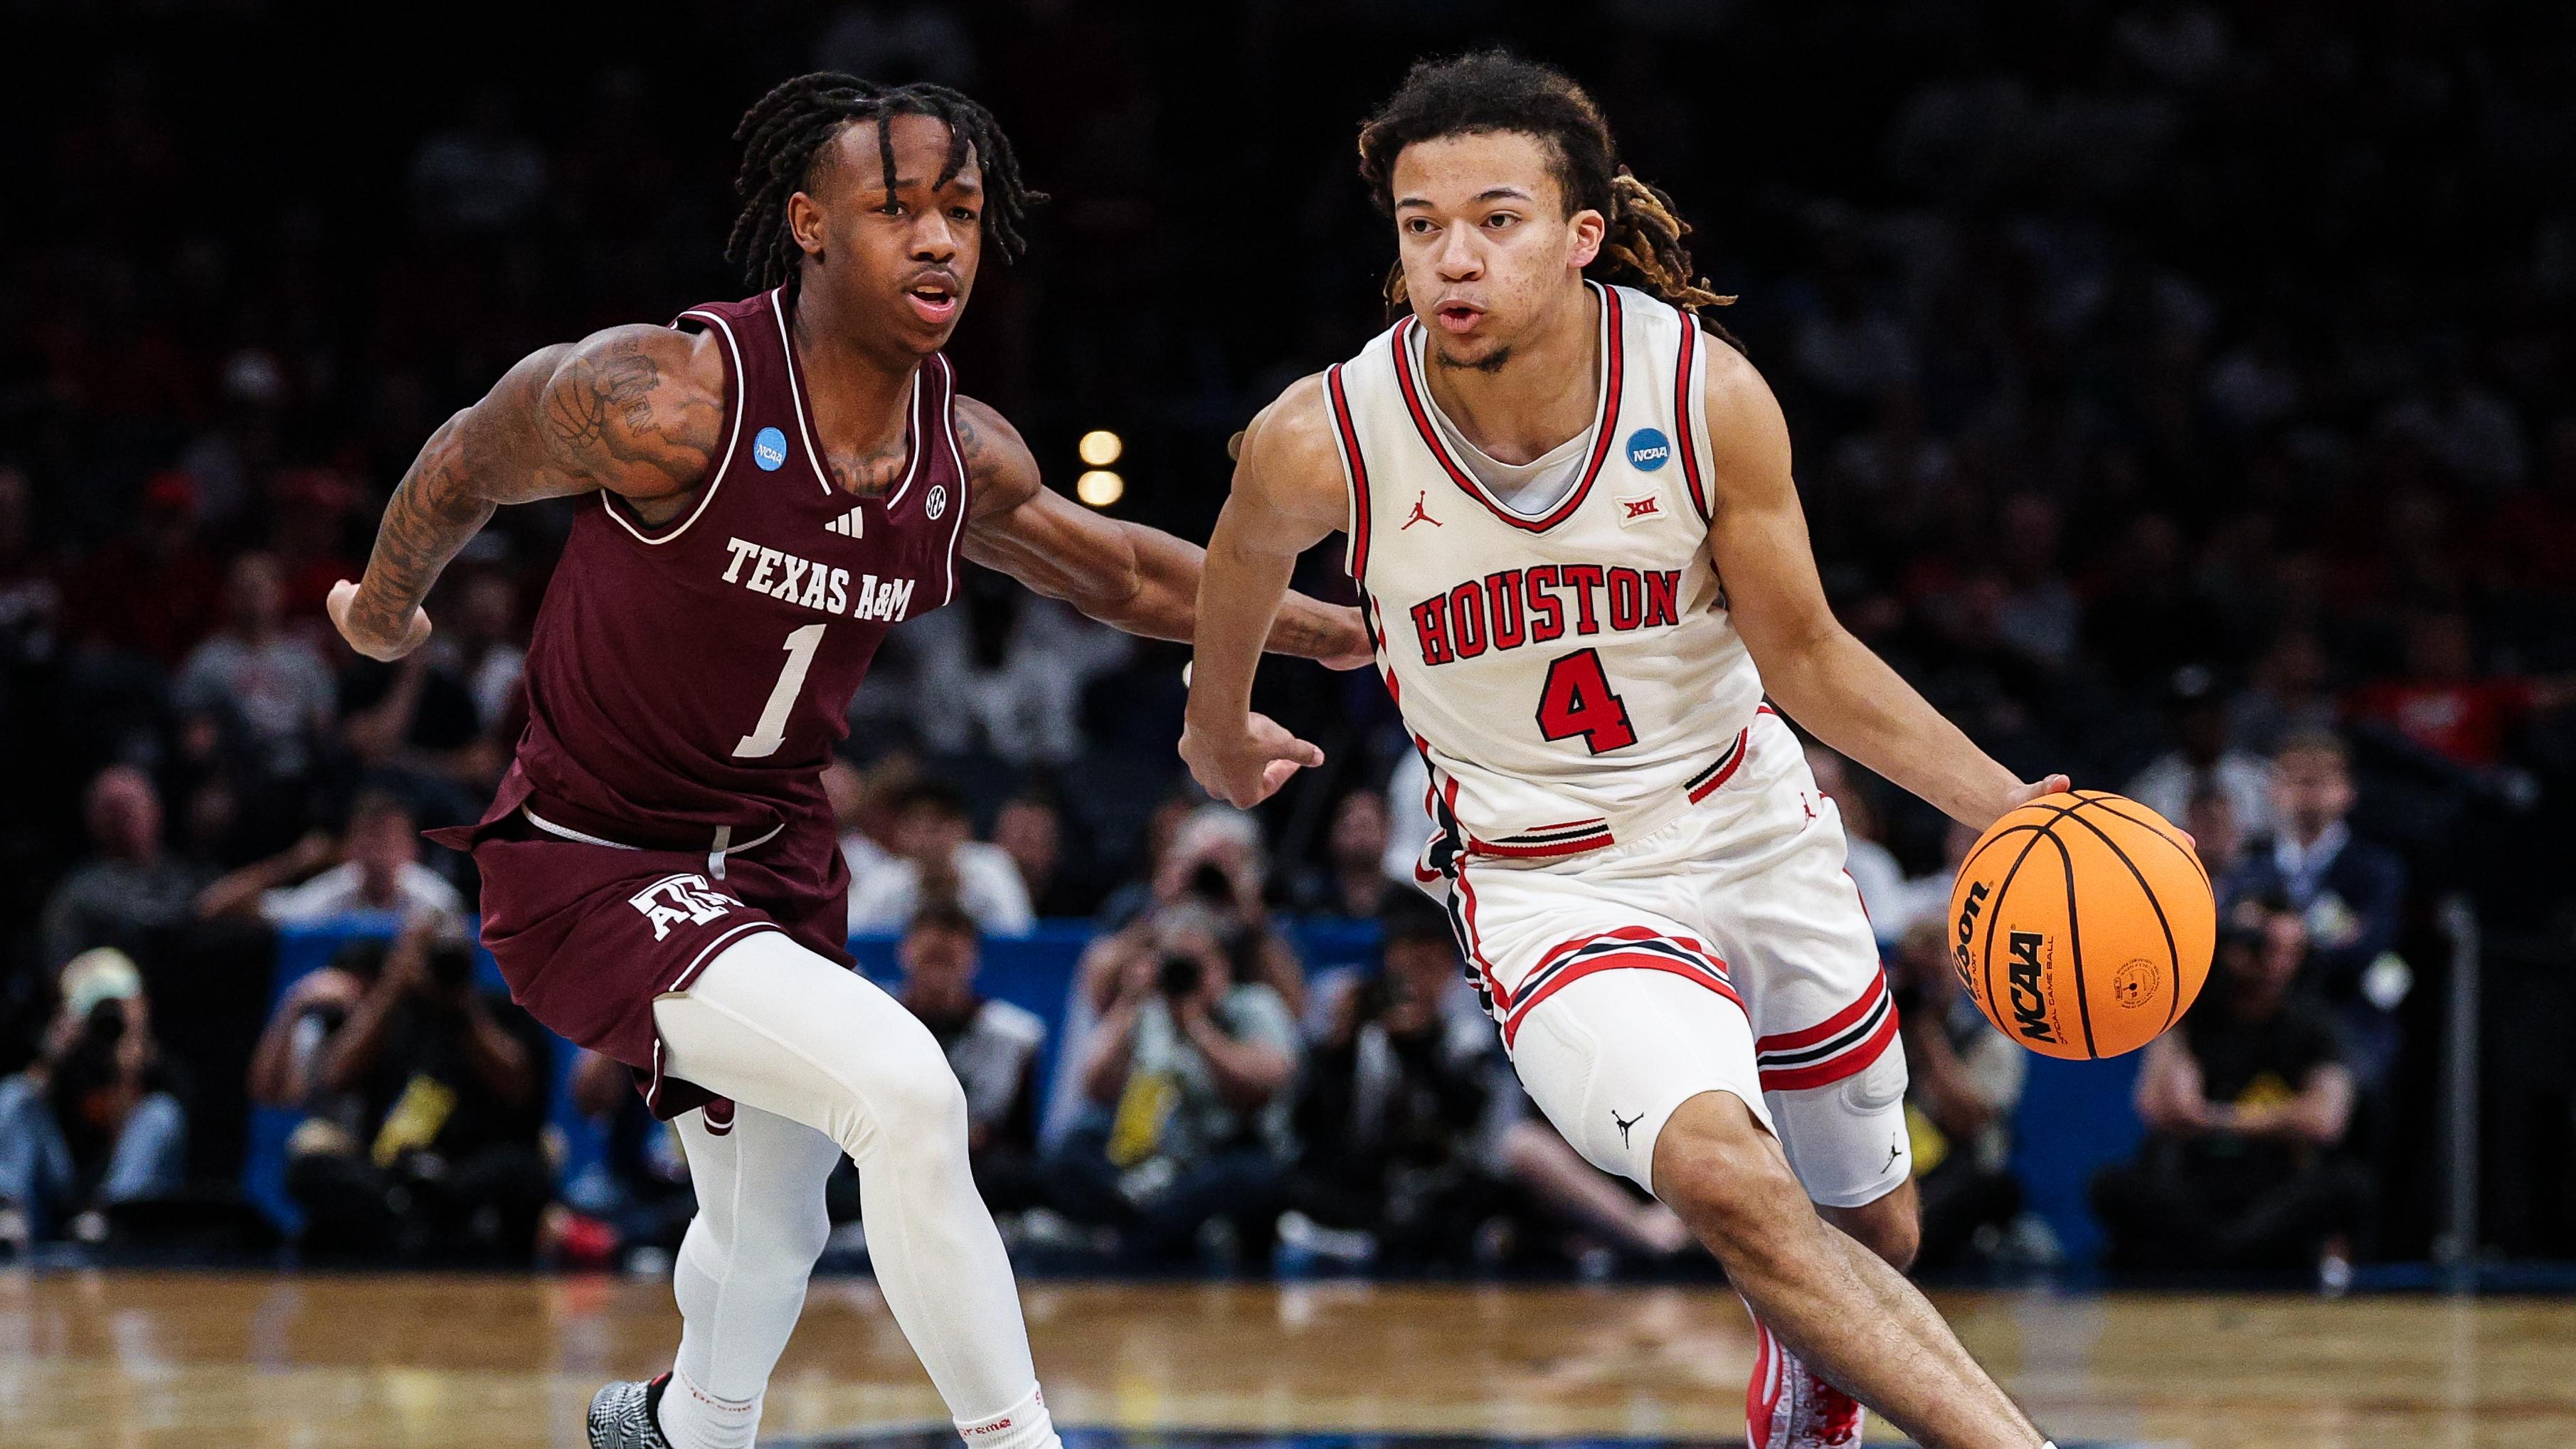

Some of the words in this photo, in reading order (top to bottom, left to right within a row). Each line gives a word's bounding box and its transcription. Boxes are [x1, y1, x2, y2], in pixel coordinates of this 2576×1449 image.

[757, 444, 783, 466] NCAA
[1633, 446, 1668, 462] NCAA
[927, 487, 944, 517] SEC
[1623, 496, 1659, 519] XII
[721, 536, 850, 615] TEXAS
[854, 574, 916, 622] A&M
[1409, 563, 1682, 667] HOUSTON
[731, 623, 827, 758] 1
[1535, 647, 1638, 756] 4
[2008, 930, 2057, 1044] NCAA
[2046, 971, 2055, 1006] GAME
